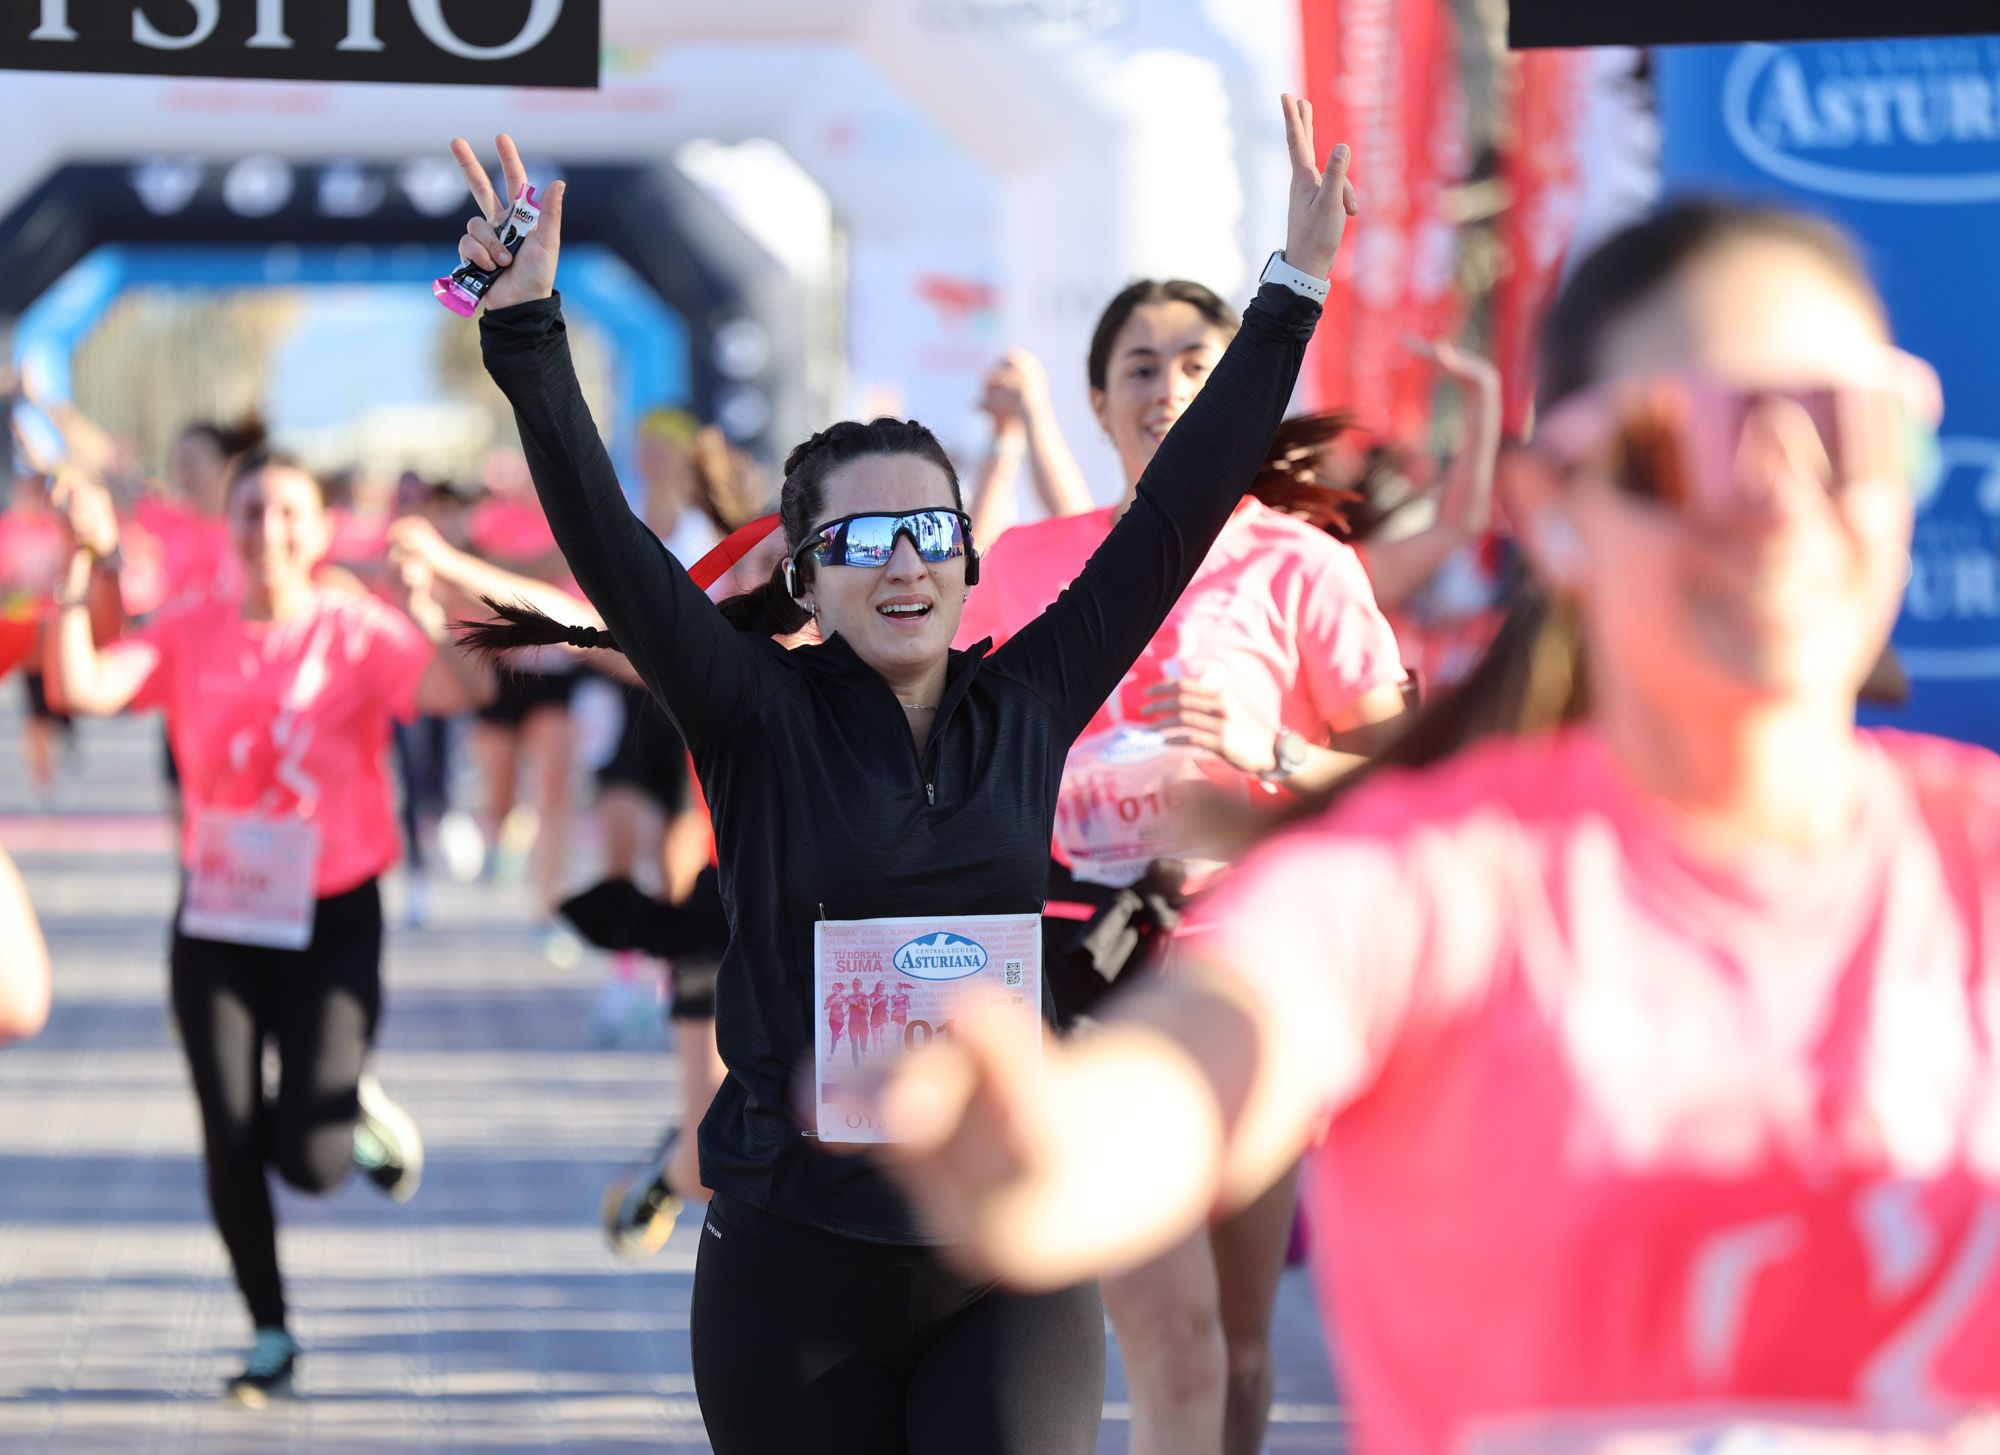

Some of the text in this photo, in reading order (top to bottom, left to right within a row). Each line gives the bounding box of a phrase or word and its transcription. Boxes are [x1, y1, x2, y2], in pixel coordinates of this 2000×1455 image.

[1757, 57, 2000, 147] ASTUR
[833, 951, 846, 959] TU
[847, 951, 883, 960] DORSAL
[836, 960, 883, 973] SUMA
[904, 1018, 954, 1053] 01
